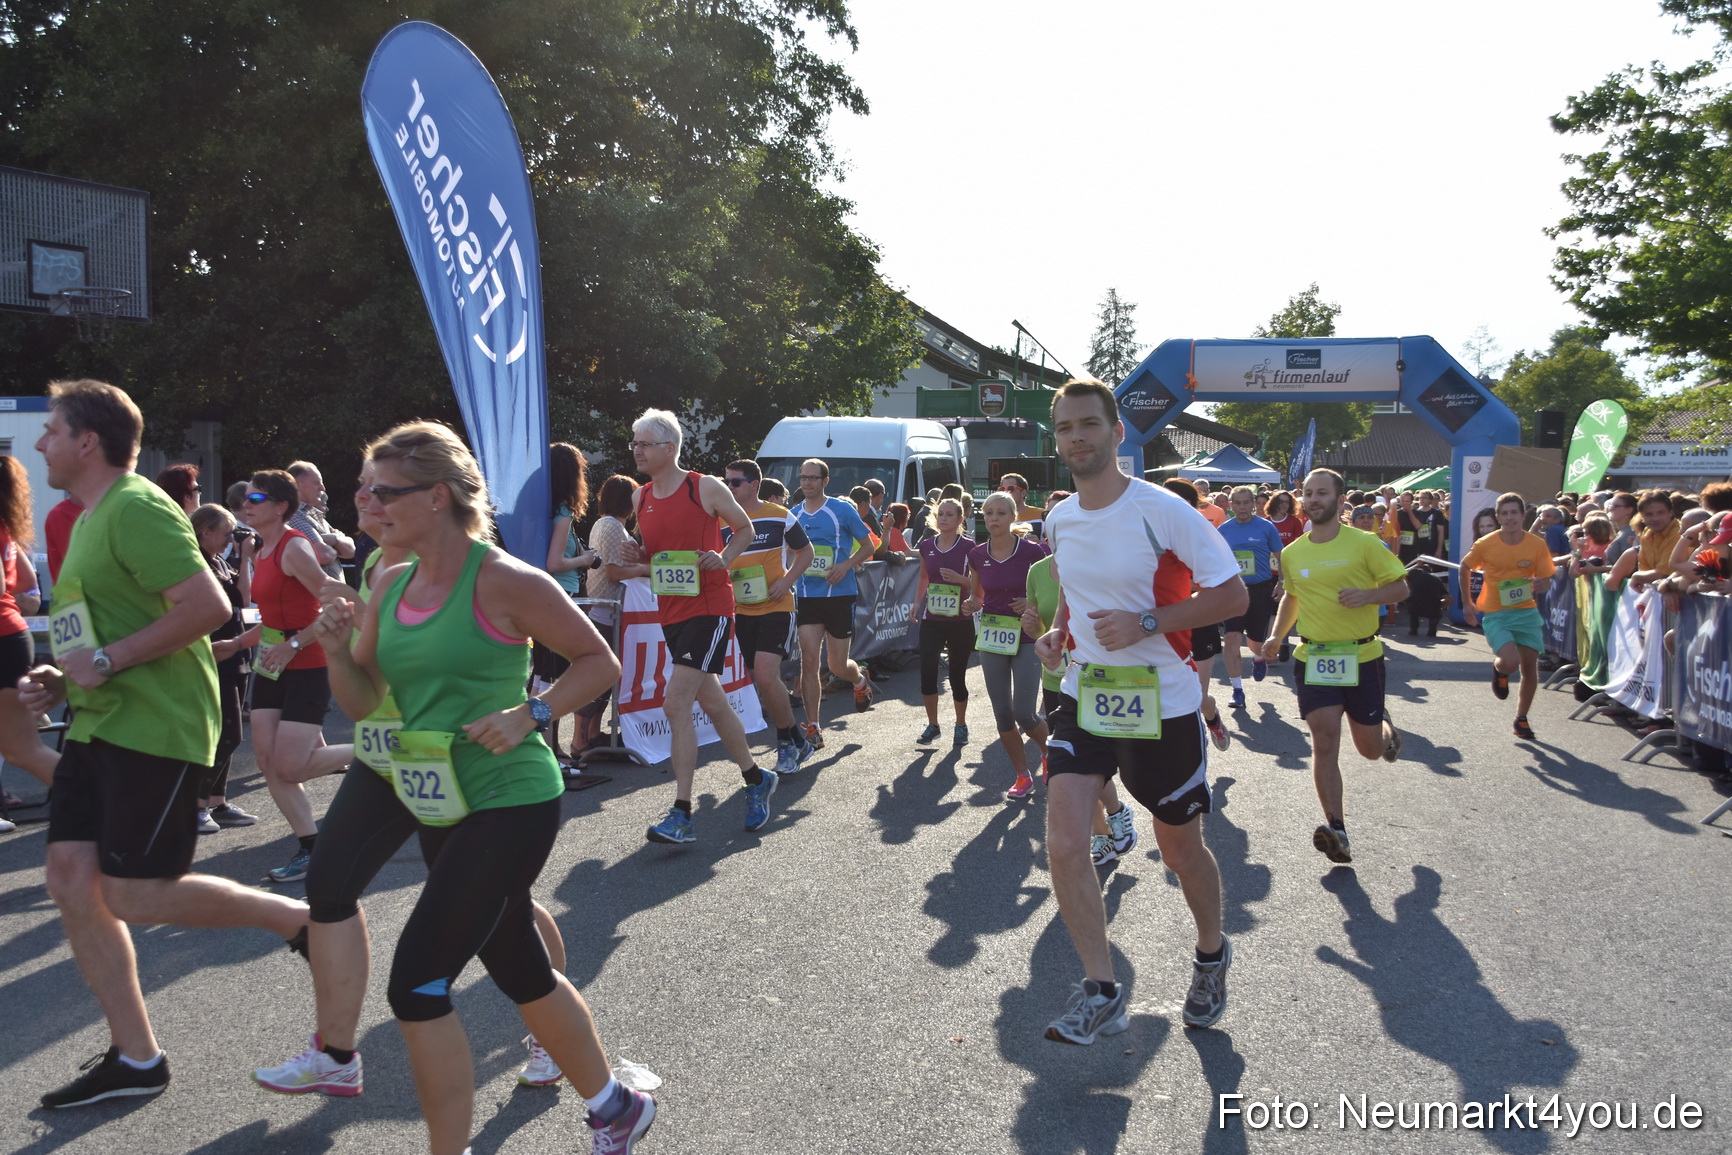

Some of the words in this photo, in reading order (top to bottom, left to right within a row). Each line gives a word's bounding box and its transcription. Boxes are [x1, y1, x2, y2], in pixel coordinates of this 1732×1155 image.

[1294, 355, 1320, 363] Fischer
[1273, 368, 1352, 383] firmenlauf
[1129, 396, 1170, 406] Fischer
[1635, 447, 1667, 457] Jura
[1567, 452, 1596, 482] AOK
[808, 558, 826, 569] 58
[1237, 560, 1249, 569] 61
[655, 568, 695, 584] 1382
[743, 582, 752, 594] 2
[1509, 588, 1523, 599] 60
[930, 595, 957, 609] 1112
[53, 612, 82, 645] 520
[983, 629, 1016, 645] 1109
[1316, 658, 1346, 674] 681
[1095, 693, 1145, 718] 824
[400, 768, 447, 800] 522
